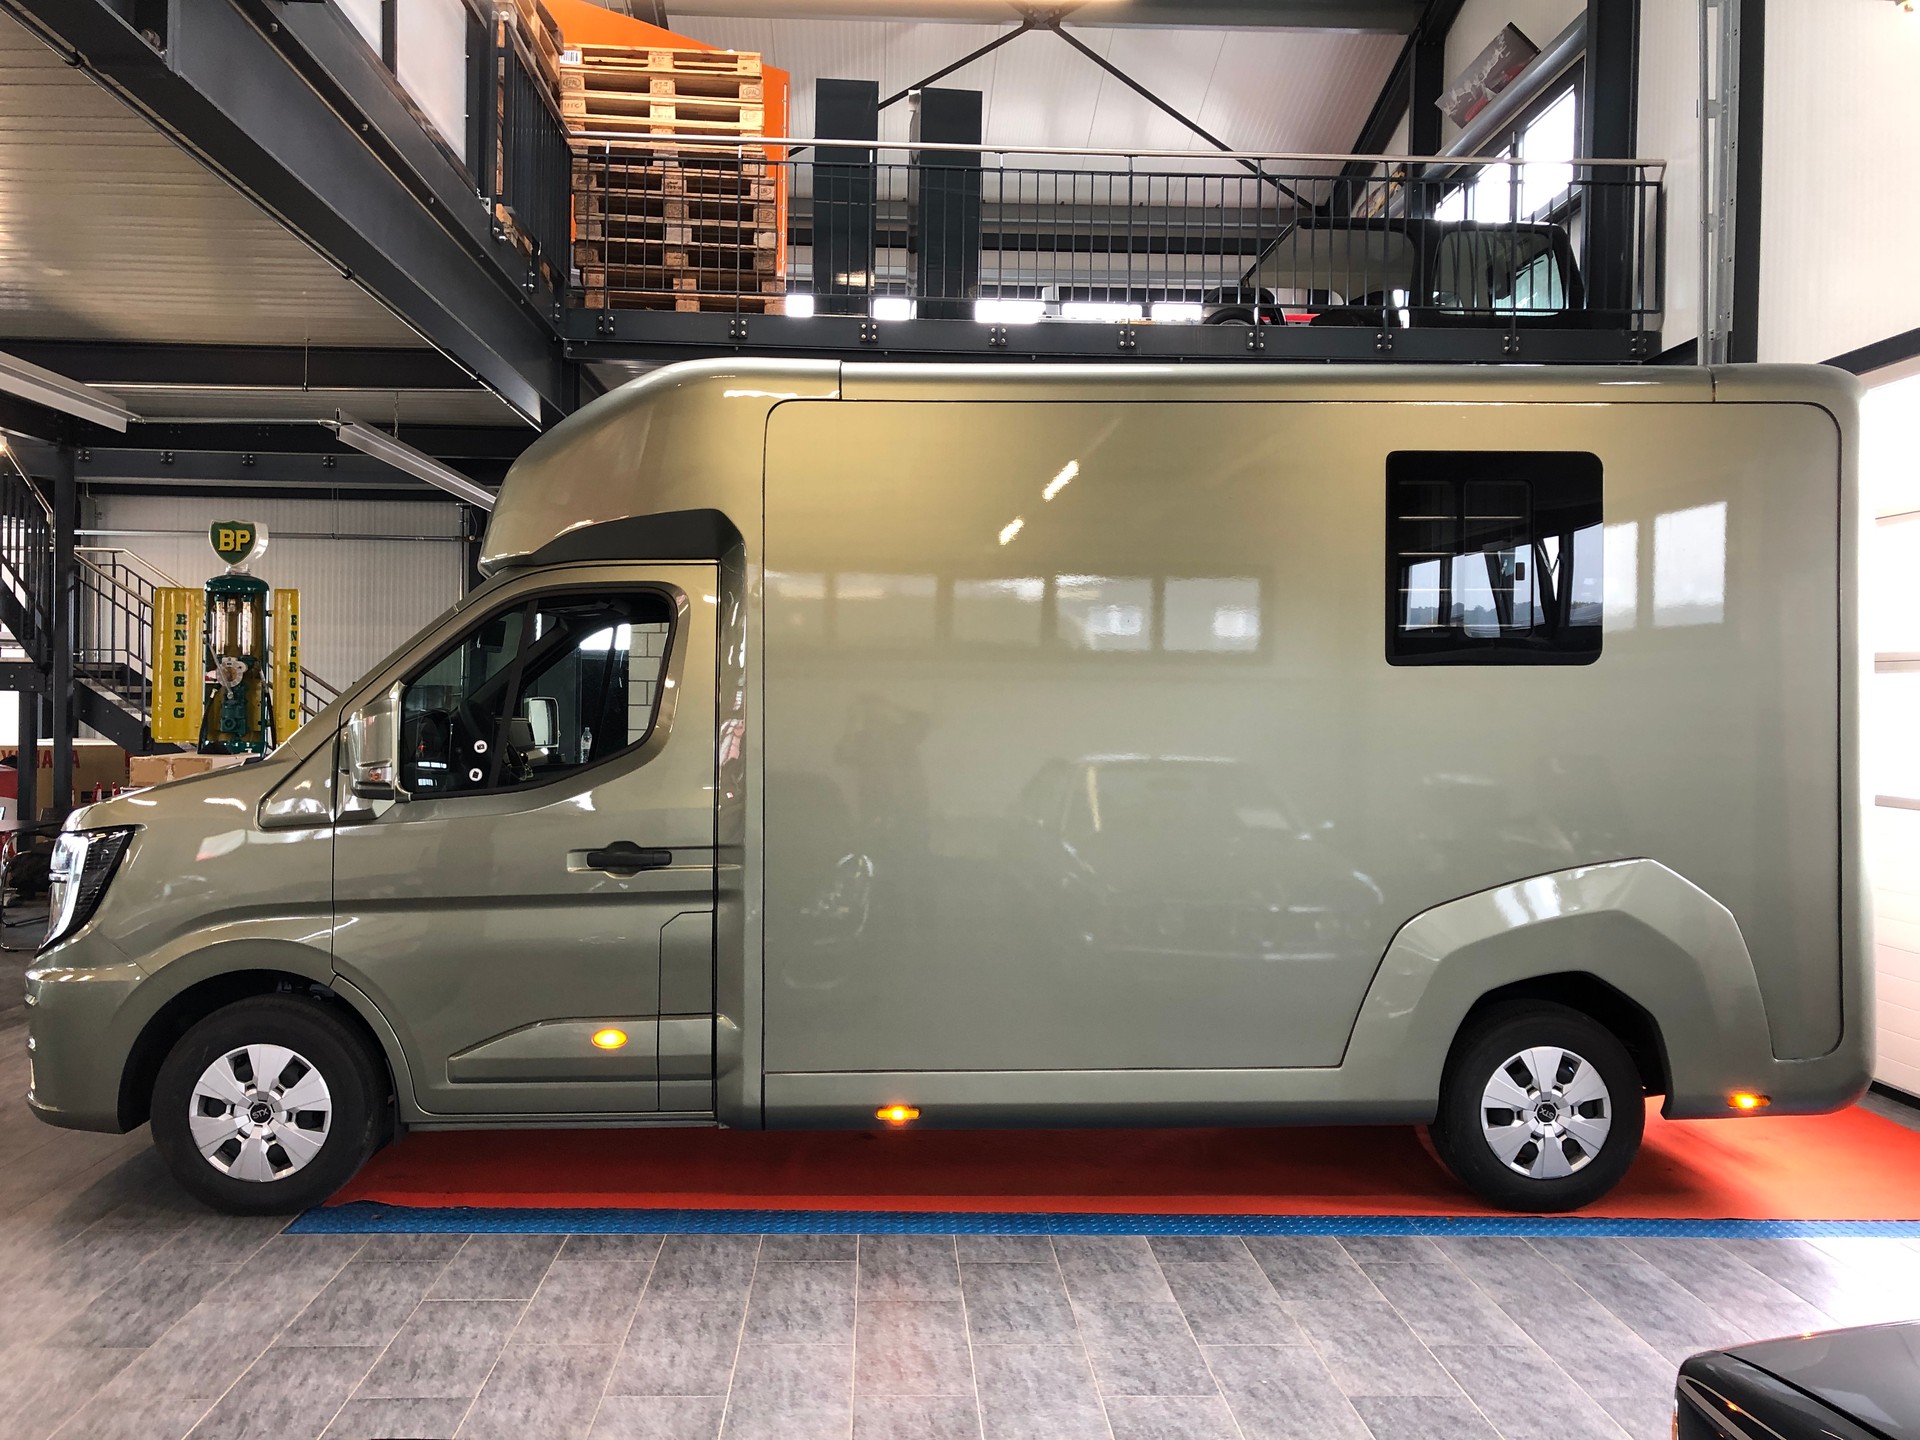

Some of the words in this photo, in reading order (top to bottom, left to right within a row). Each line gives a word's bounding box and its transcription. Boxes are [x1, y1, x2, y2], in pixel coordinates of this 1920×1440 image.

[218, 528, 251, 551] BP
[173, 613, 188, 719] ENERGIC
[288, 614, 297, 720] ENERGIC
[252, 1108, 269, 1119] STX
